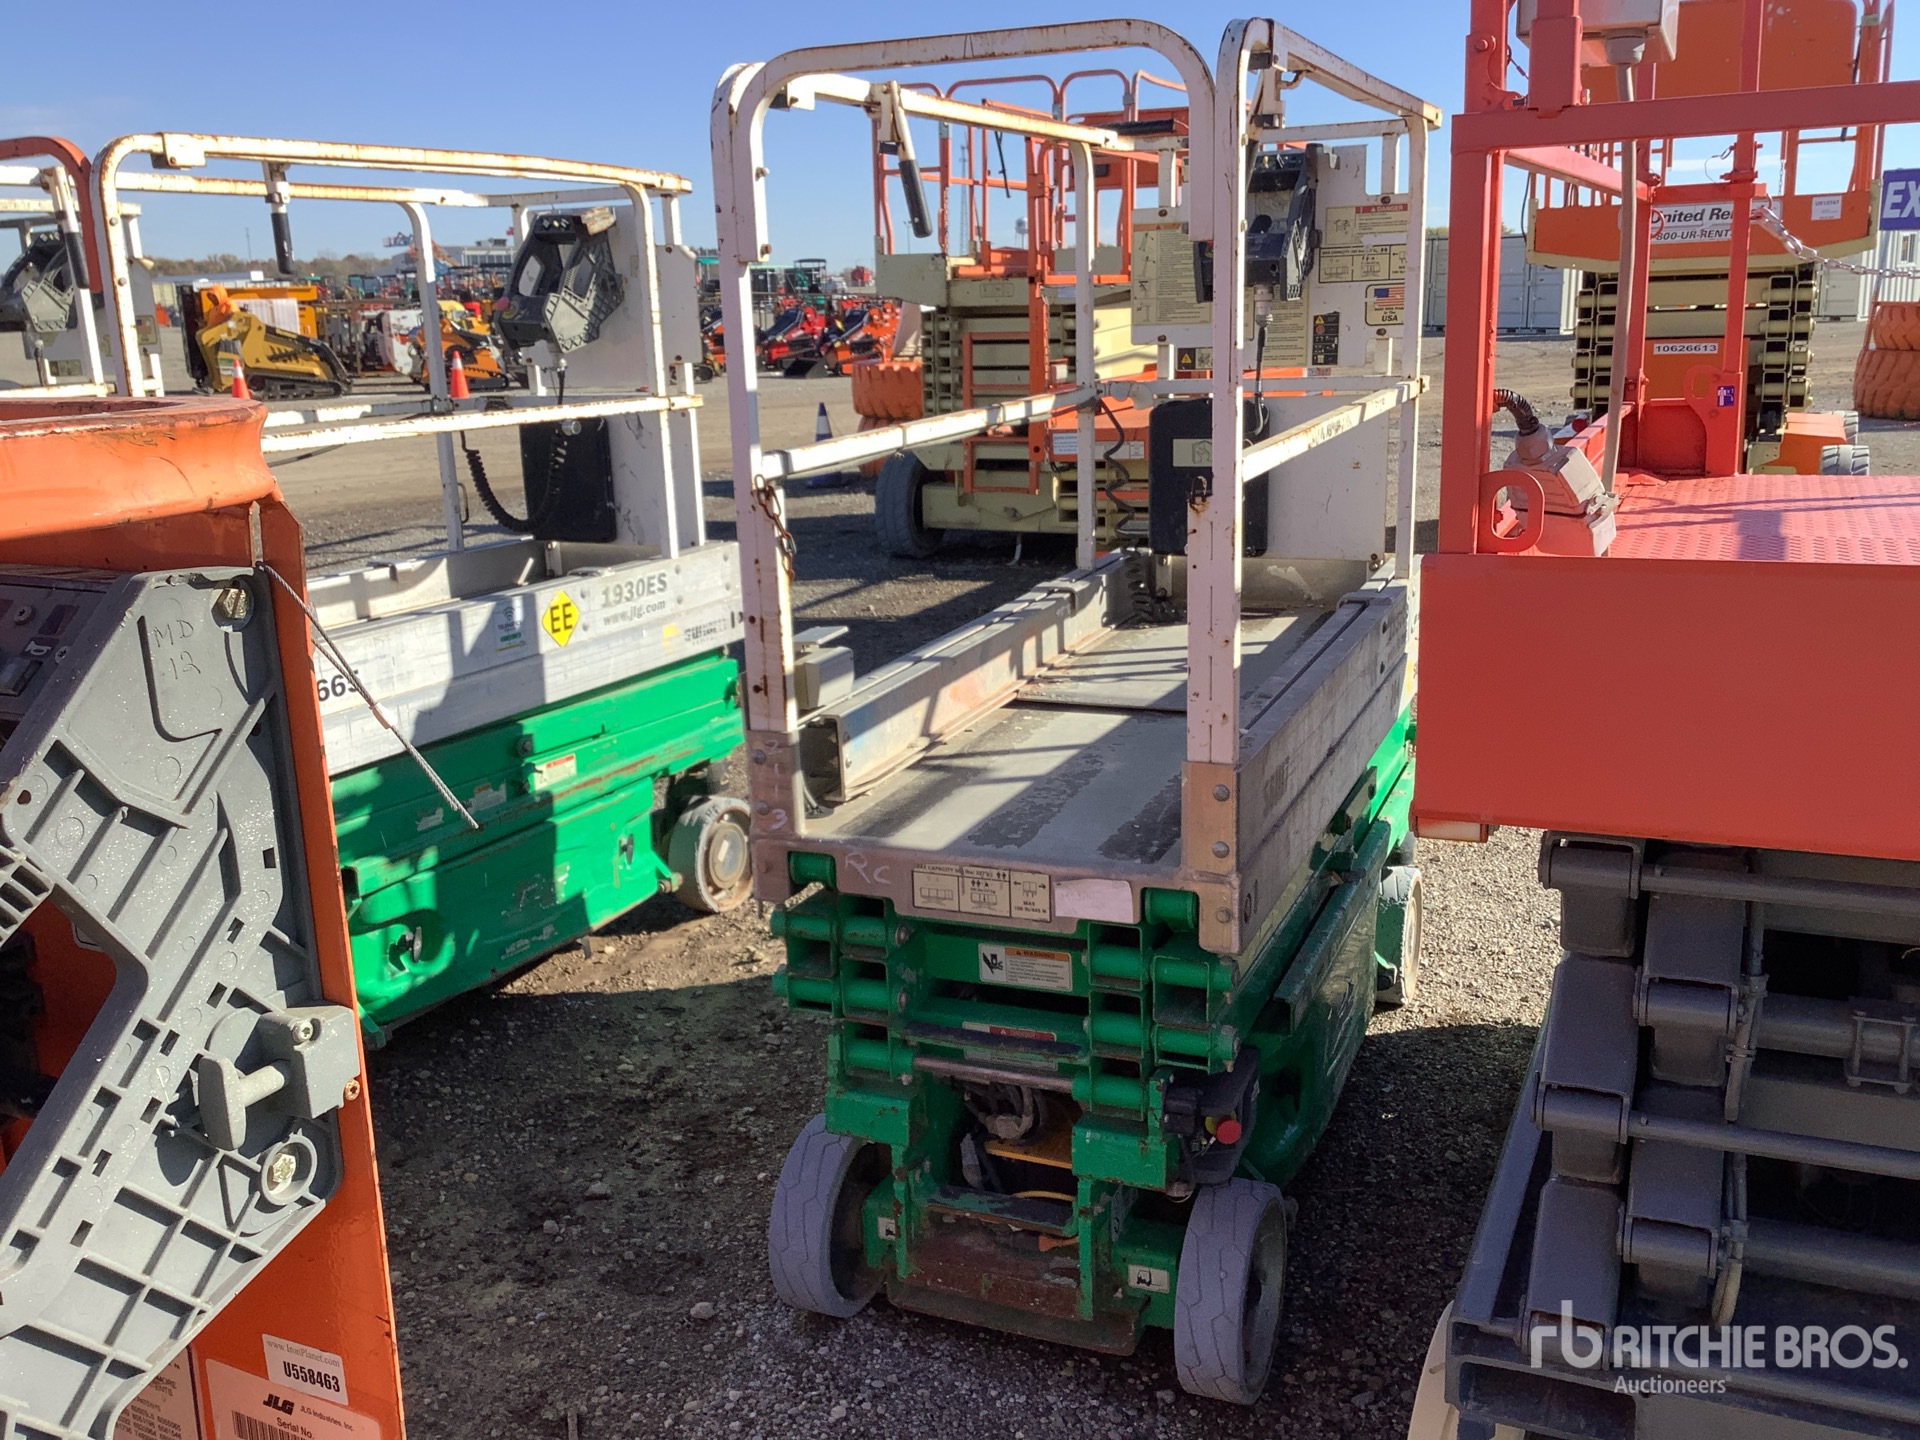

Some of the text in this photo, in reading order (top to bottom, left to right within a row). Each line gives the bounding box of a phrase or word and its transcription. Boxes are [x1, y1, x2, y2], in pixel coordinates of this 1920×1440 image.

[1382, 314, 1398, 322] USA
[1655, 344, 1717, 352] 10626613
[601, 573, 667, 608] 1930ES
[550, 602, 573, 634] EE
[603, 600, 666, 627] www.jlg.com
[283, 1360, 341, 1393] U558463
[263, 1393, 295, 1416] JLG
[300, 1405, 312, 1415] JLG
[276, 1417, 315, 1440] Serial No.
